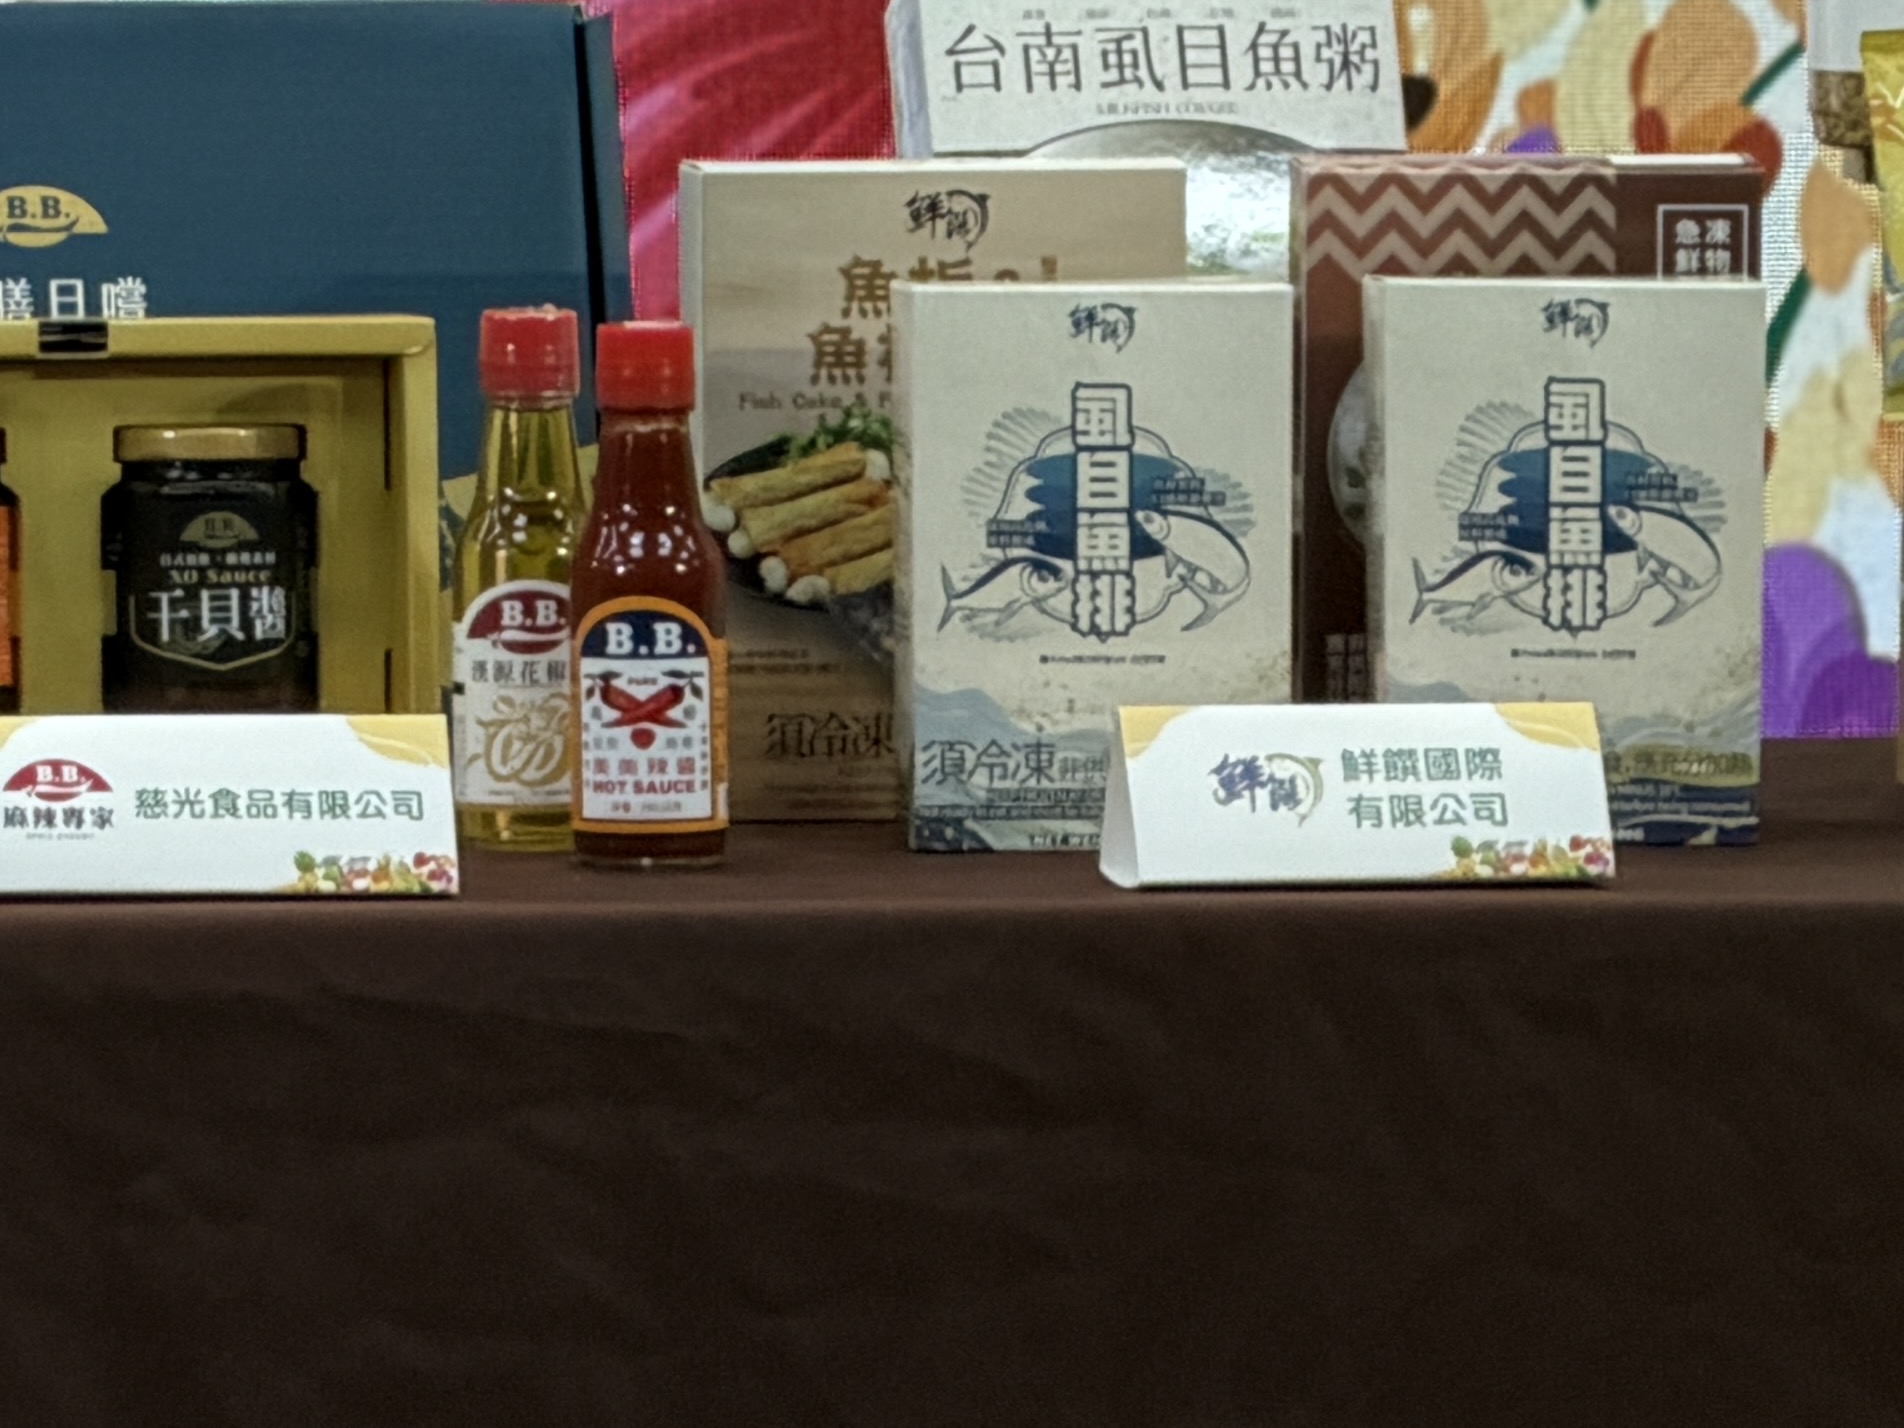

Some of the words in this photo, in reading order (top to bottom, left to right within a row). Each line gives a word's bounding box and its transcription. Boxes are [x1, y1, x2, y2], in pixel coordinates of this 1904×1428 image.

[944, 20, 1382, 96] 台南虱目魚粥
[6, 195, 72, 220] B.B.
[738, 392, 783, 411] Fish
[792, 392, 843, 411] Cake
[206, 568, 272, 585] Sauce
[146, 585, 287, 644] 干貝醬
[500, 599, 567, 627] B.B.
[605, 621, 696, 656] B.B.
[35, 764, 86, 784] B.B.
[920, 739, 1058, 786] 須冷凍
[1340, 746, 1503, 783] 鮮饌國際
[133, 786, 425, 822] 慈光食品有限公司
[592, 779, 626, 795] HOT
[632, 779, 697, 795] SAUCE
[1346, 792, 1509, 829] 有限公司
